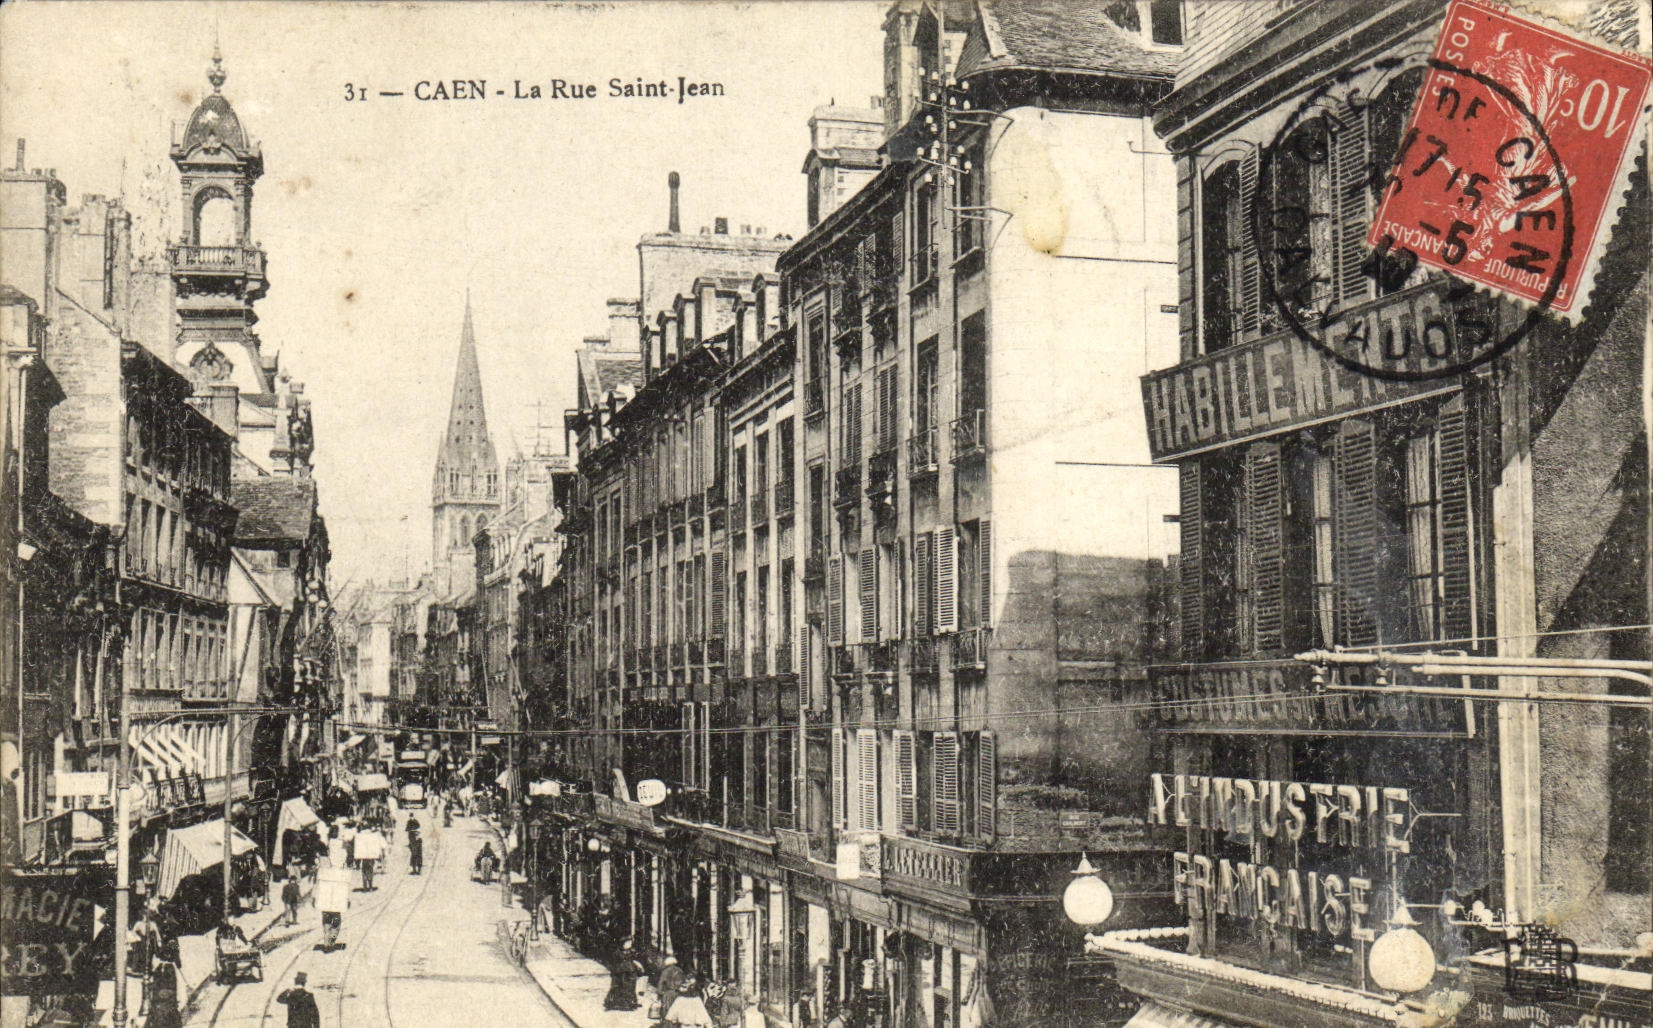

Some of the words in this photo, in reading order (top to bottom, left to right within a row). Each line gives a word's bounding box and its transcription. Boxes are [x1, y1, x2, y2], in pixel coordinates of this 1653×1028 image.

[1577, 79, 1630, 138] 10
[1496, 137, 1556, 274] CAEN
[1483, 257, 1569, 299] RPUBLIQUE
[1151, 292, 1443, 451] HABILLEMENTS
[1158, 668, 1288, 722] COSTUMES
[1174, 774, 1410, 854] L'INDUSTRIE
